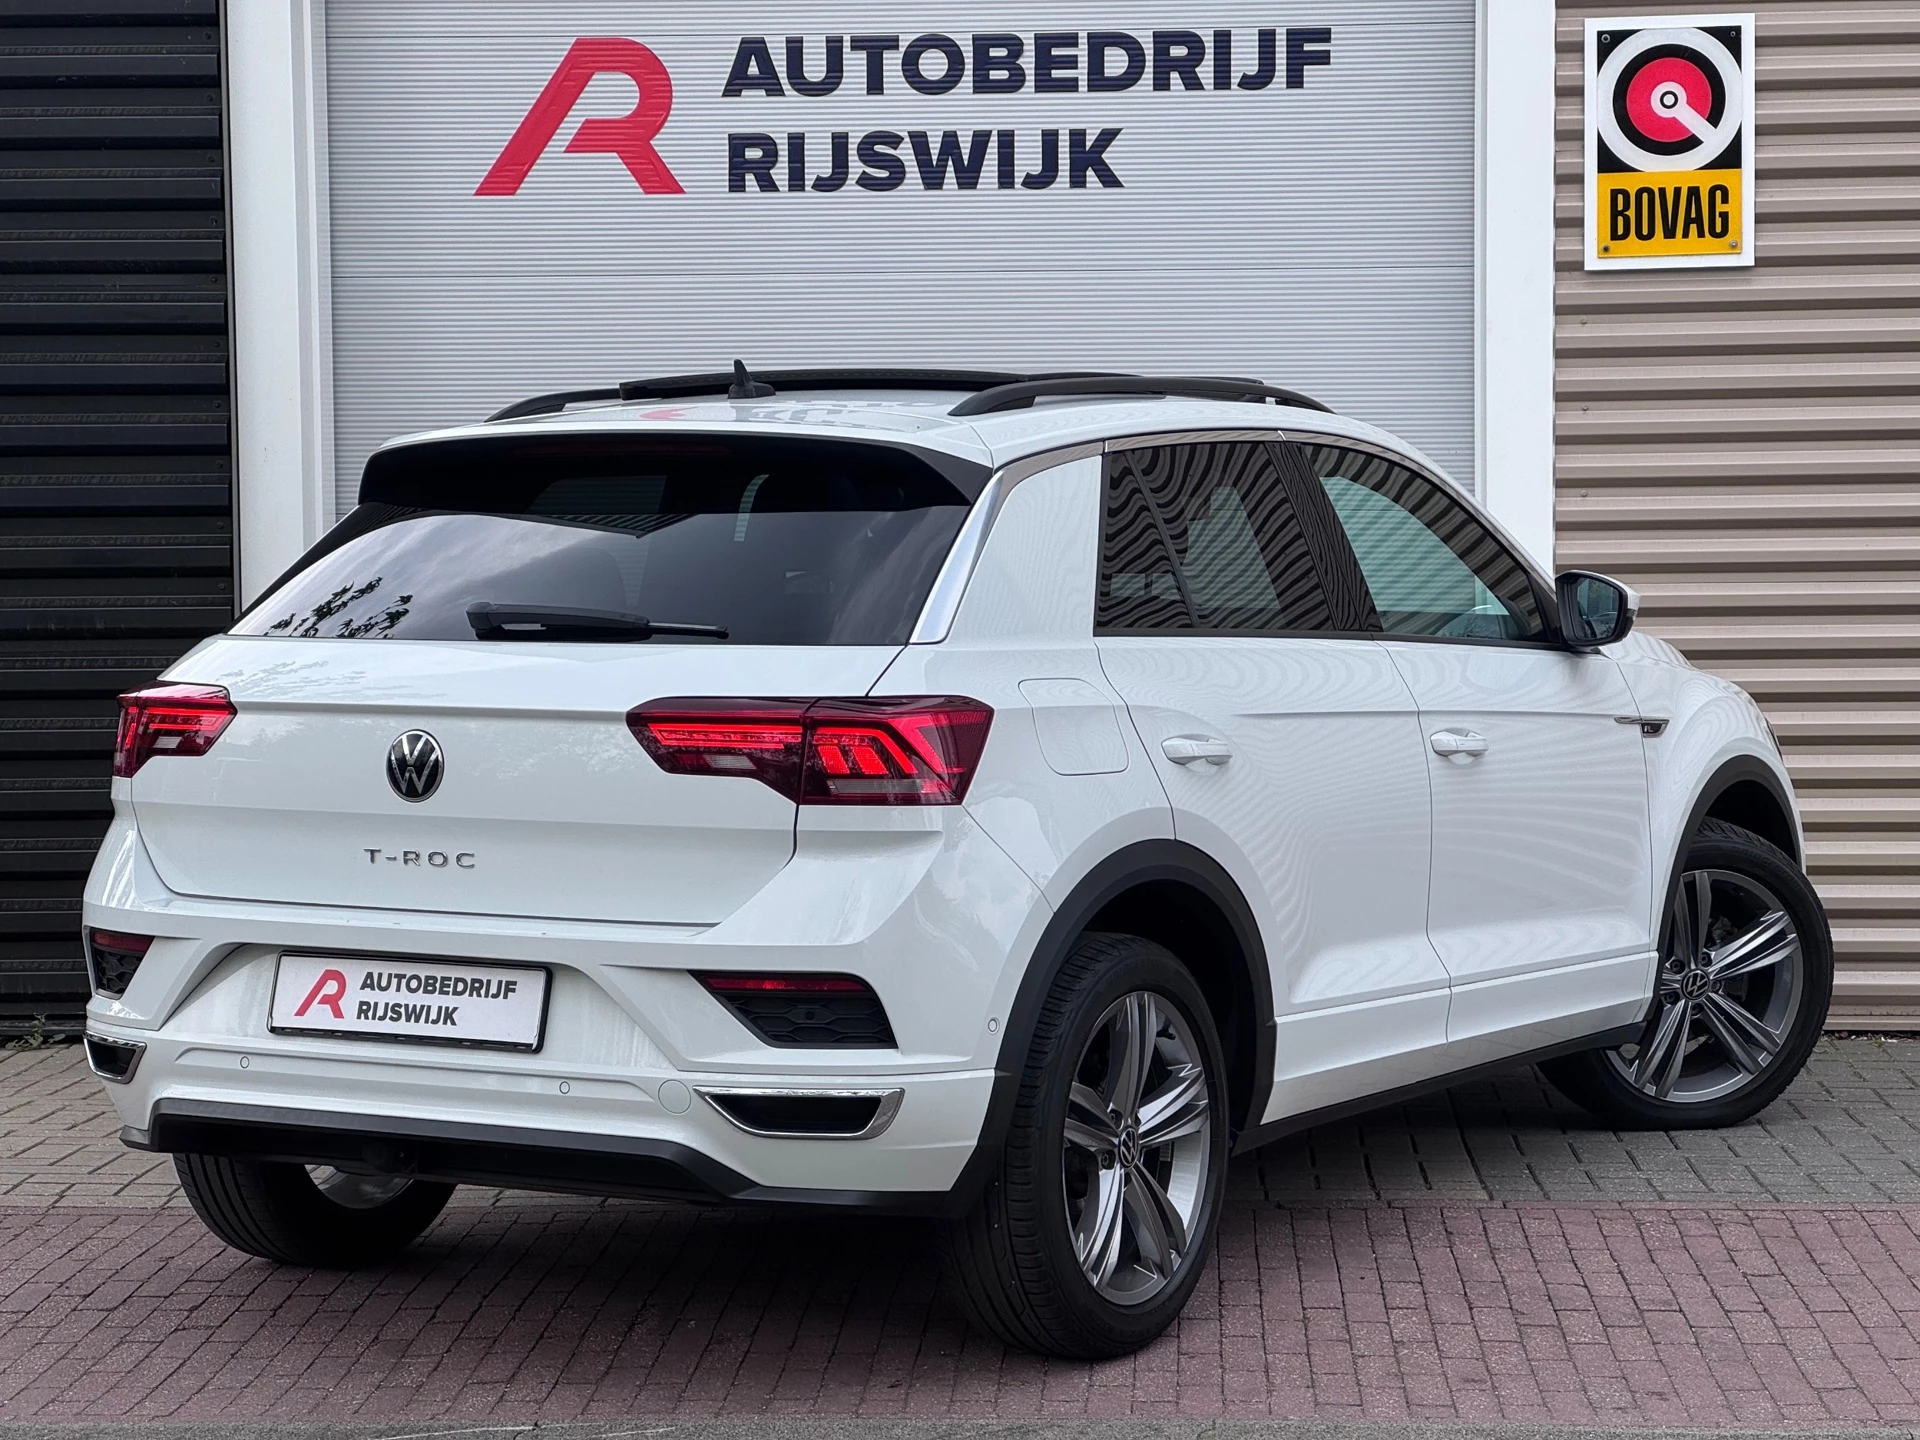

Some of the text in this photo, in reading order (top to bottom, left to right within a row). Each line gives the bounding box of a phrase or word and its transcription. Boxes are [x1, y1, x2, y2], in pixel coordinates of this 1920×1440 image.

[722, 27, 1332, 97] AUTOBEDRIJF
[727, 128, 1124, 193] RIJSWIJK
[1609, 184, 1730, 241] BOVAG
[363, 848, 476, 869] T-ROC
[359, 971, 518, 1000] AUTOBEDRIJF
[356, 1000, 460, 1027] RIJSWIJK
